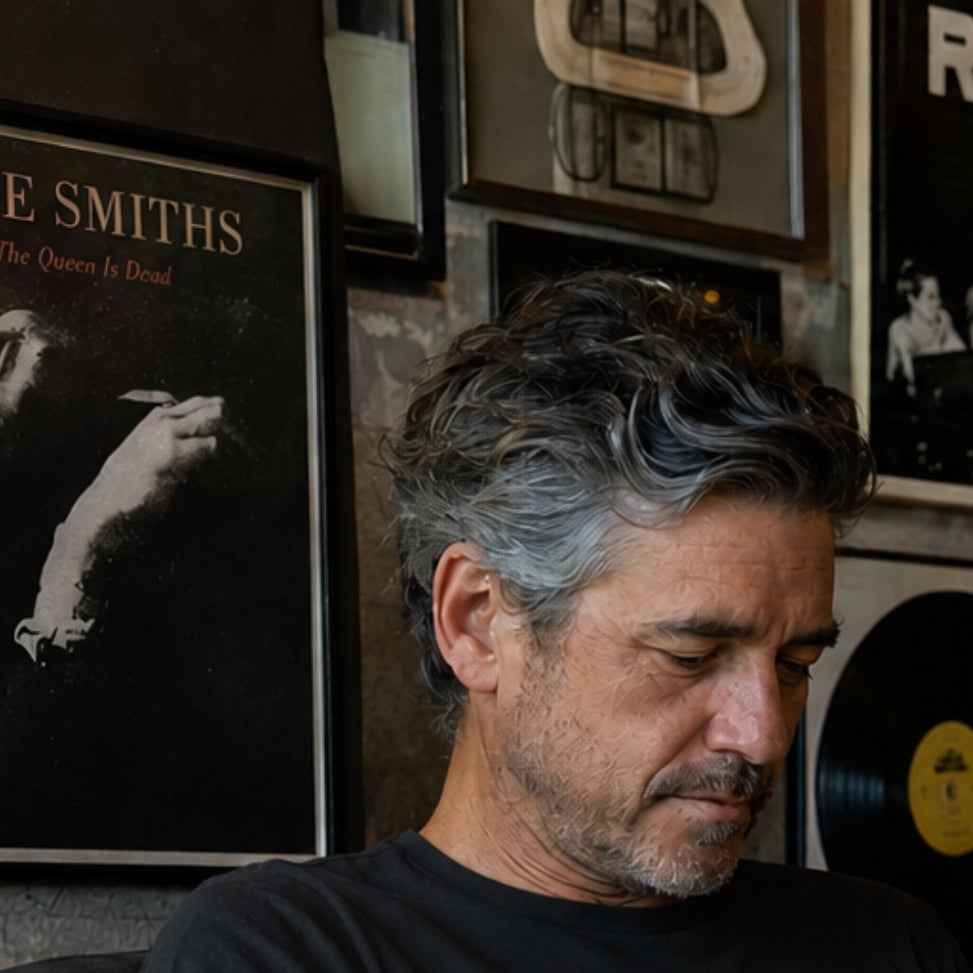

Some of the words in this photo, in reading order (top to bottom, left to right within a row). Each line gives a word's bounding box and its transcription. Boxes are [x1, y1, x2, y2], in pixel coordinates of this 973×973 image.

[54, 180, 244, 256] SMITHS
[0, 239, 31, 266] The
[38, 245, 96, 275] Queen
[103, 256, 119, 278] Is
[125, 259, 173, 286] Dead
